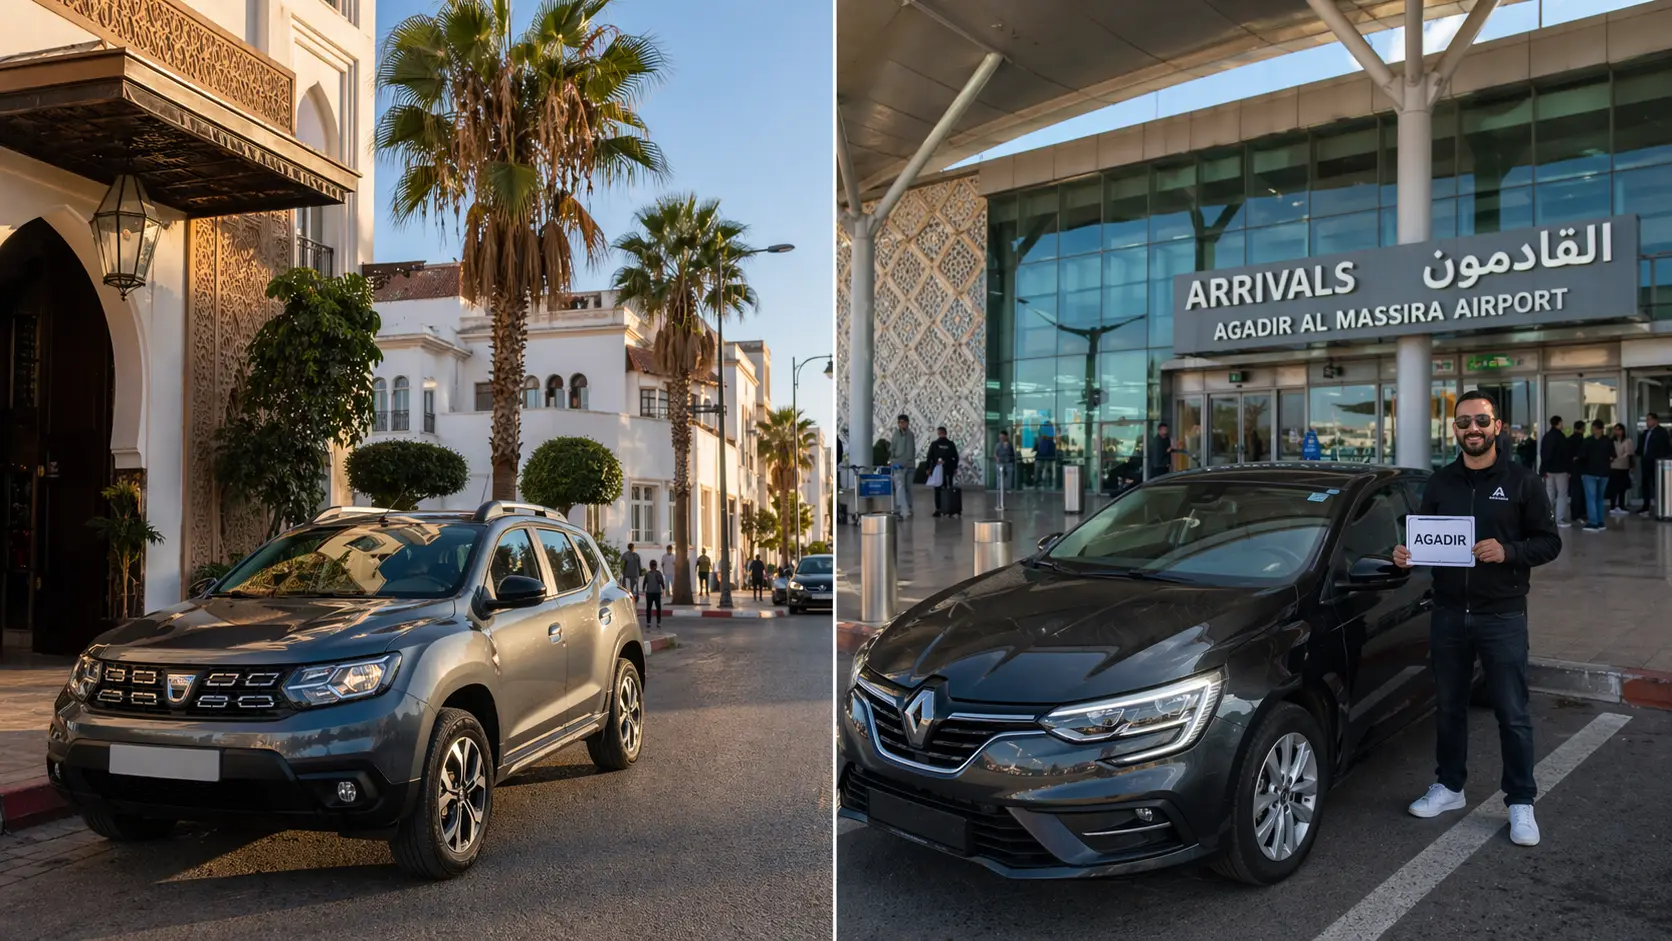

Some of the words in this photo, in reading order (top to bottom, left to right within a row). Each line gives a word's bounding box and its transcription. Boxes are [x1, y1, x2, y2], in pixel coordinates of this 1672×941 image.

[1423, 222, 1612, 289] القادمون
[1185, 261, 1356, 310] ARRIVALS
[1213, 316, 1292, 341] AGADIR
[1300, 313, 1328, 333] AL
[1336, 301, 1444, 329] MASSIRA
[1453, 287, 1568, 320] AIRPORT
[1413, 533, 1467, 546] AGADIR
